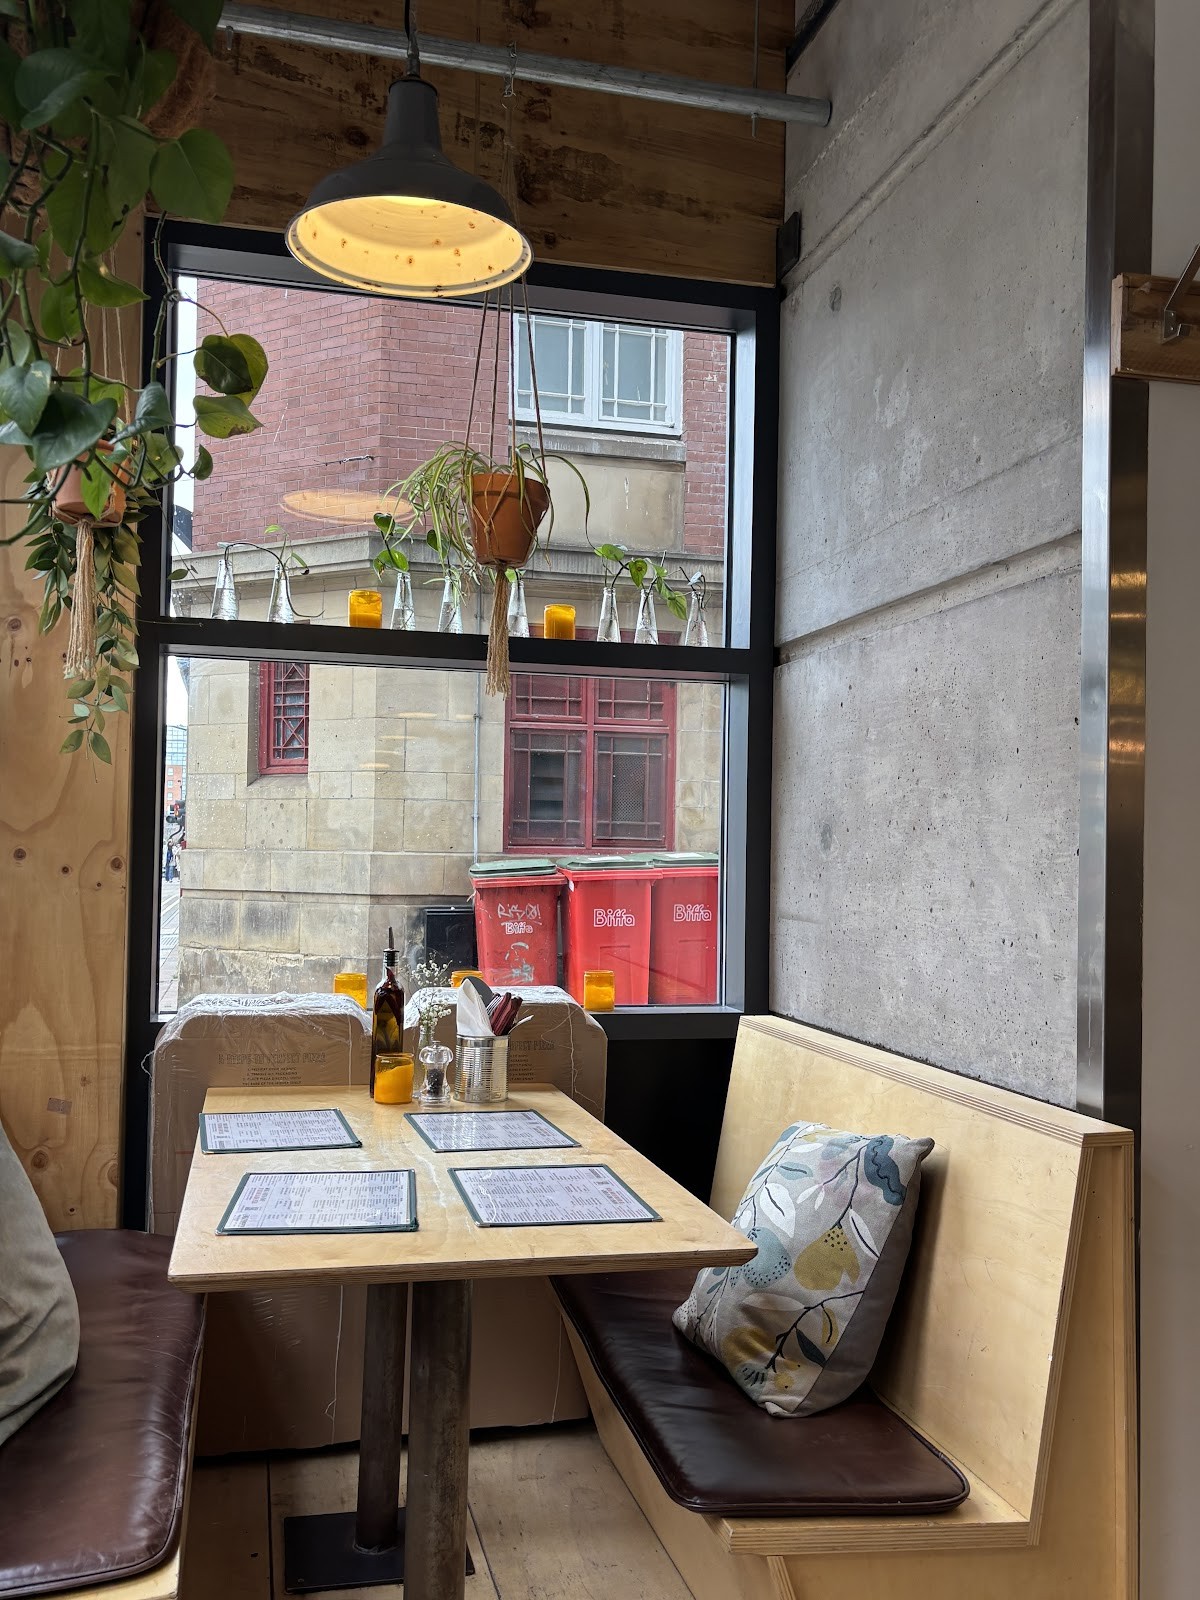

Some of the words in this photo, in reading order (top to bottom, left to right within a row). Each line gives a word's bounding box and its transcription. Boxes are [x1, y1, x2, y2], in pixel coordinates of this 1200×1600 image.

[593, 908, 636, 928] Biffa
[673, 904, 712, 922] Biffa
[505, 922, 534, 935] Biffa
